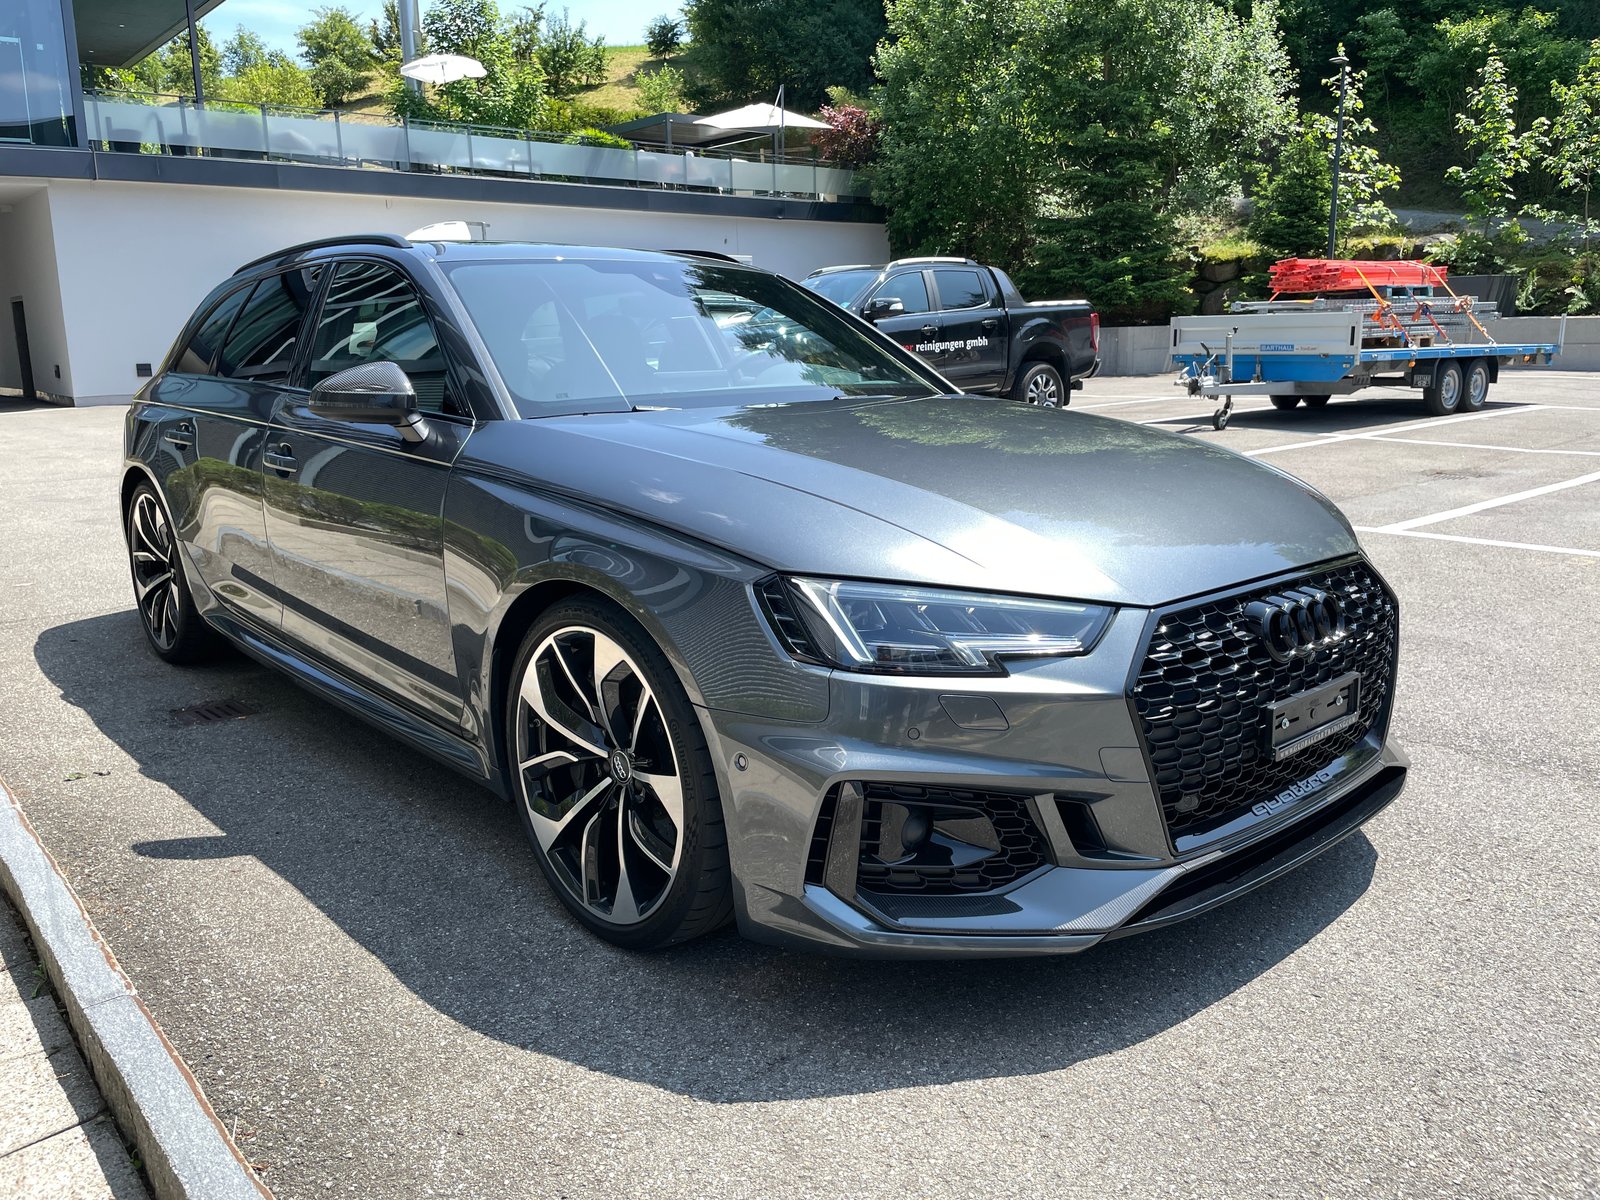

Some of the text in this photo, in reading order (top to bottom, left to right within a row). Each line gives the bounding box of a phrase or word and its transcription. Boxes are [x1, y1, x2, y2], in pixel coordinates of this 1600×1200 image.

[916, 340, 964, 353] reinigungen
[966, 336, 988, 349] gmbh
[1252, 772, 1332, 816] quattro
